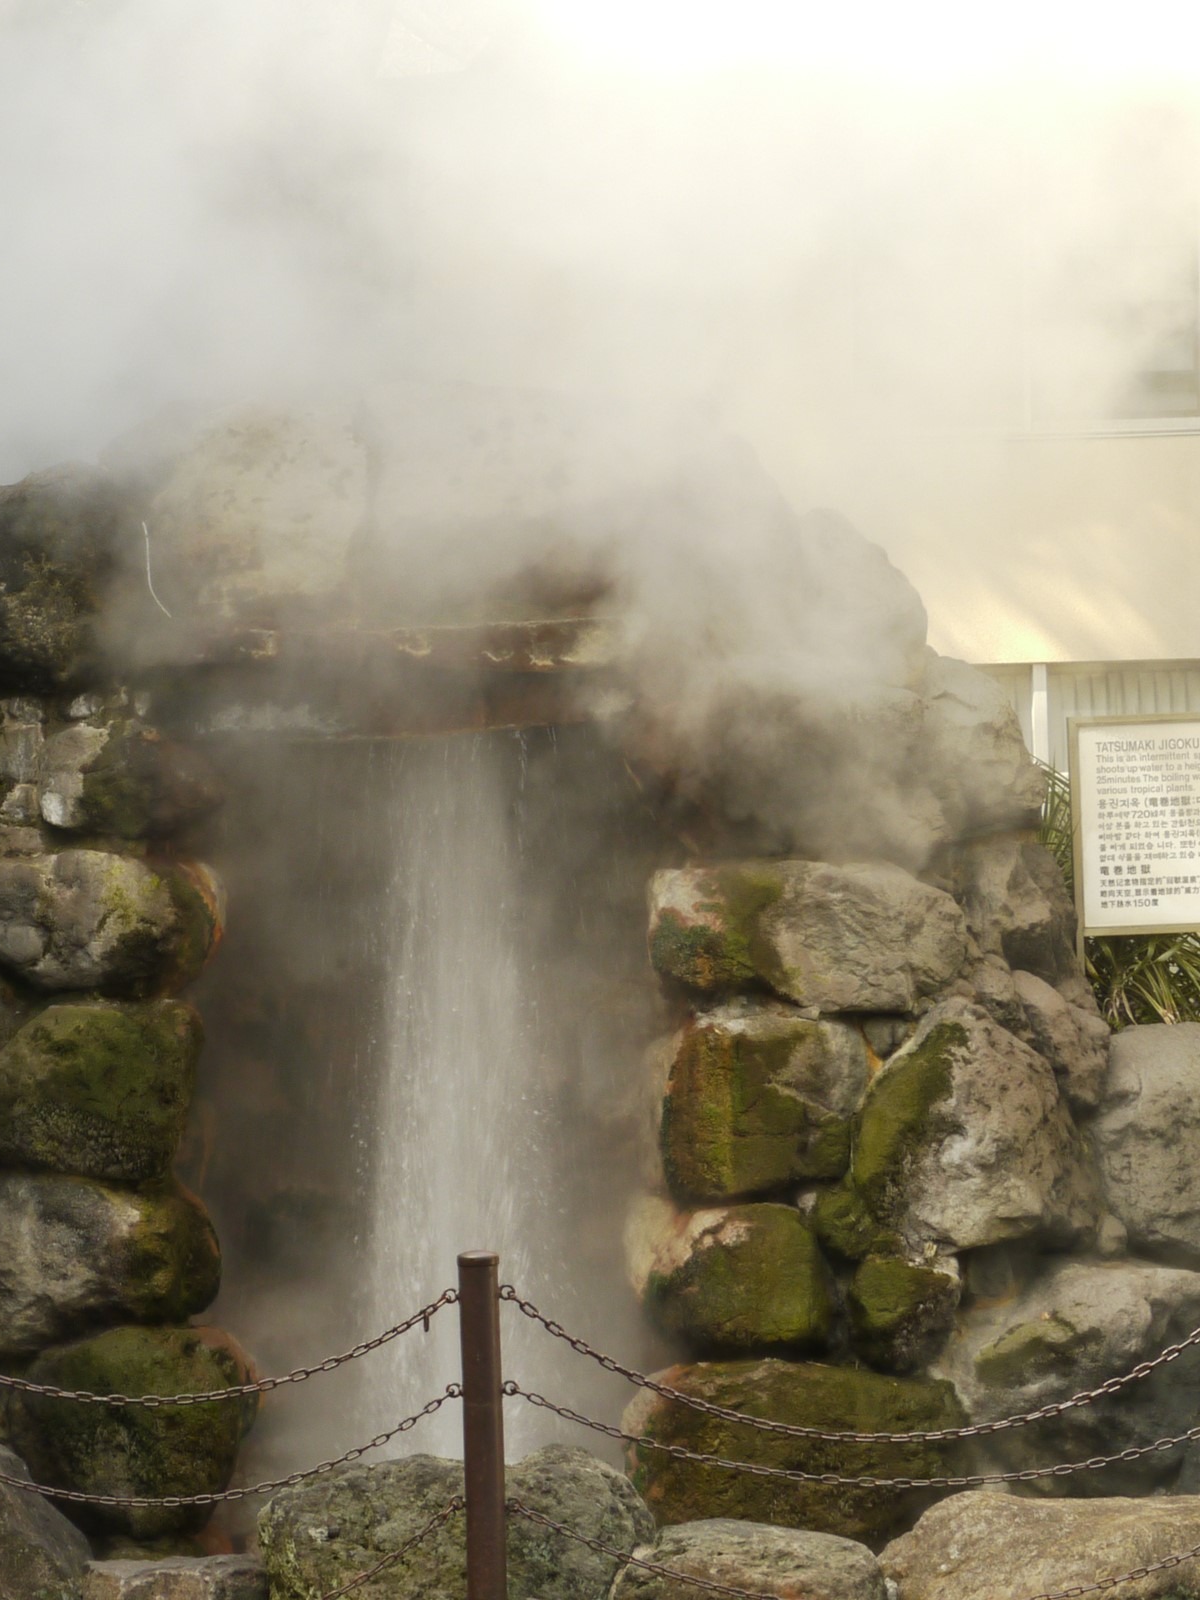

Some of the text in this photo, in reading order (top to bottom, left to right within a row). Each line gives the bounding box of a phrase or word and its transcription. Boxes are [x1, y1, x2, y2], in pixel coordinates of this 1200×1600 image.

[1095, 737, 1200, 753] TATSUMAKI JIGOKU
[1096, 754, 1114, 763] This
[1116, 754, 1124, 762] is
[1140, 751, 1190, 762] intermittent
[1096, 764, 1125, 774] shoots
[1140, 763, 1163, 772] water
[1143, 773, 1159, 782] The
[1096, 786, 1128, 795] various
[1131, 784, 1163, 795] tropical
